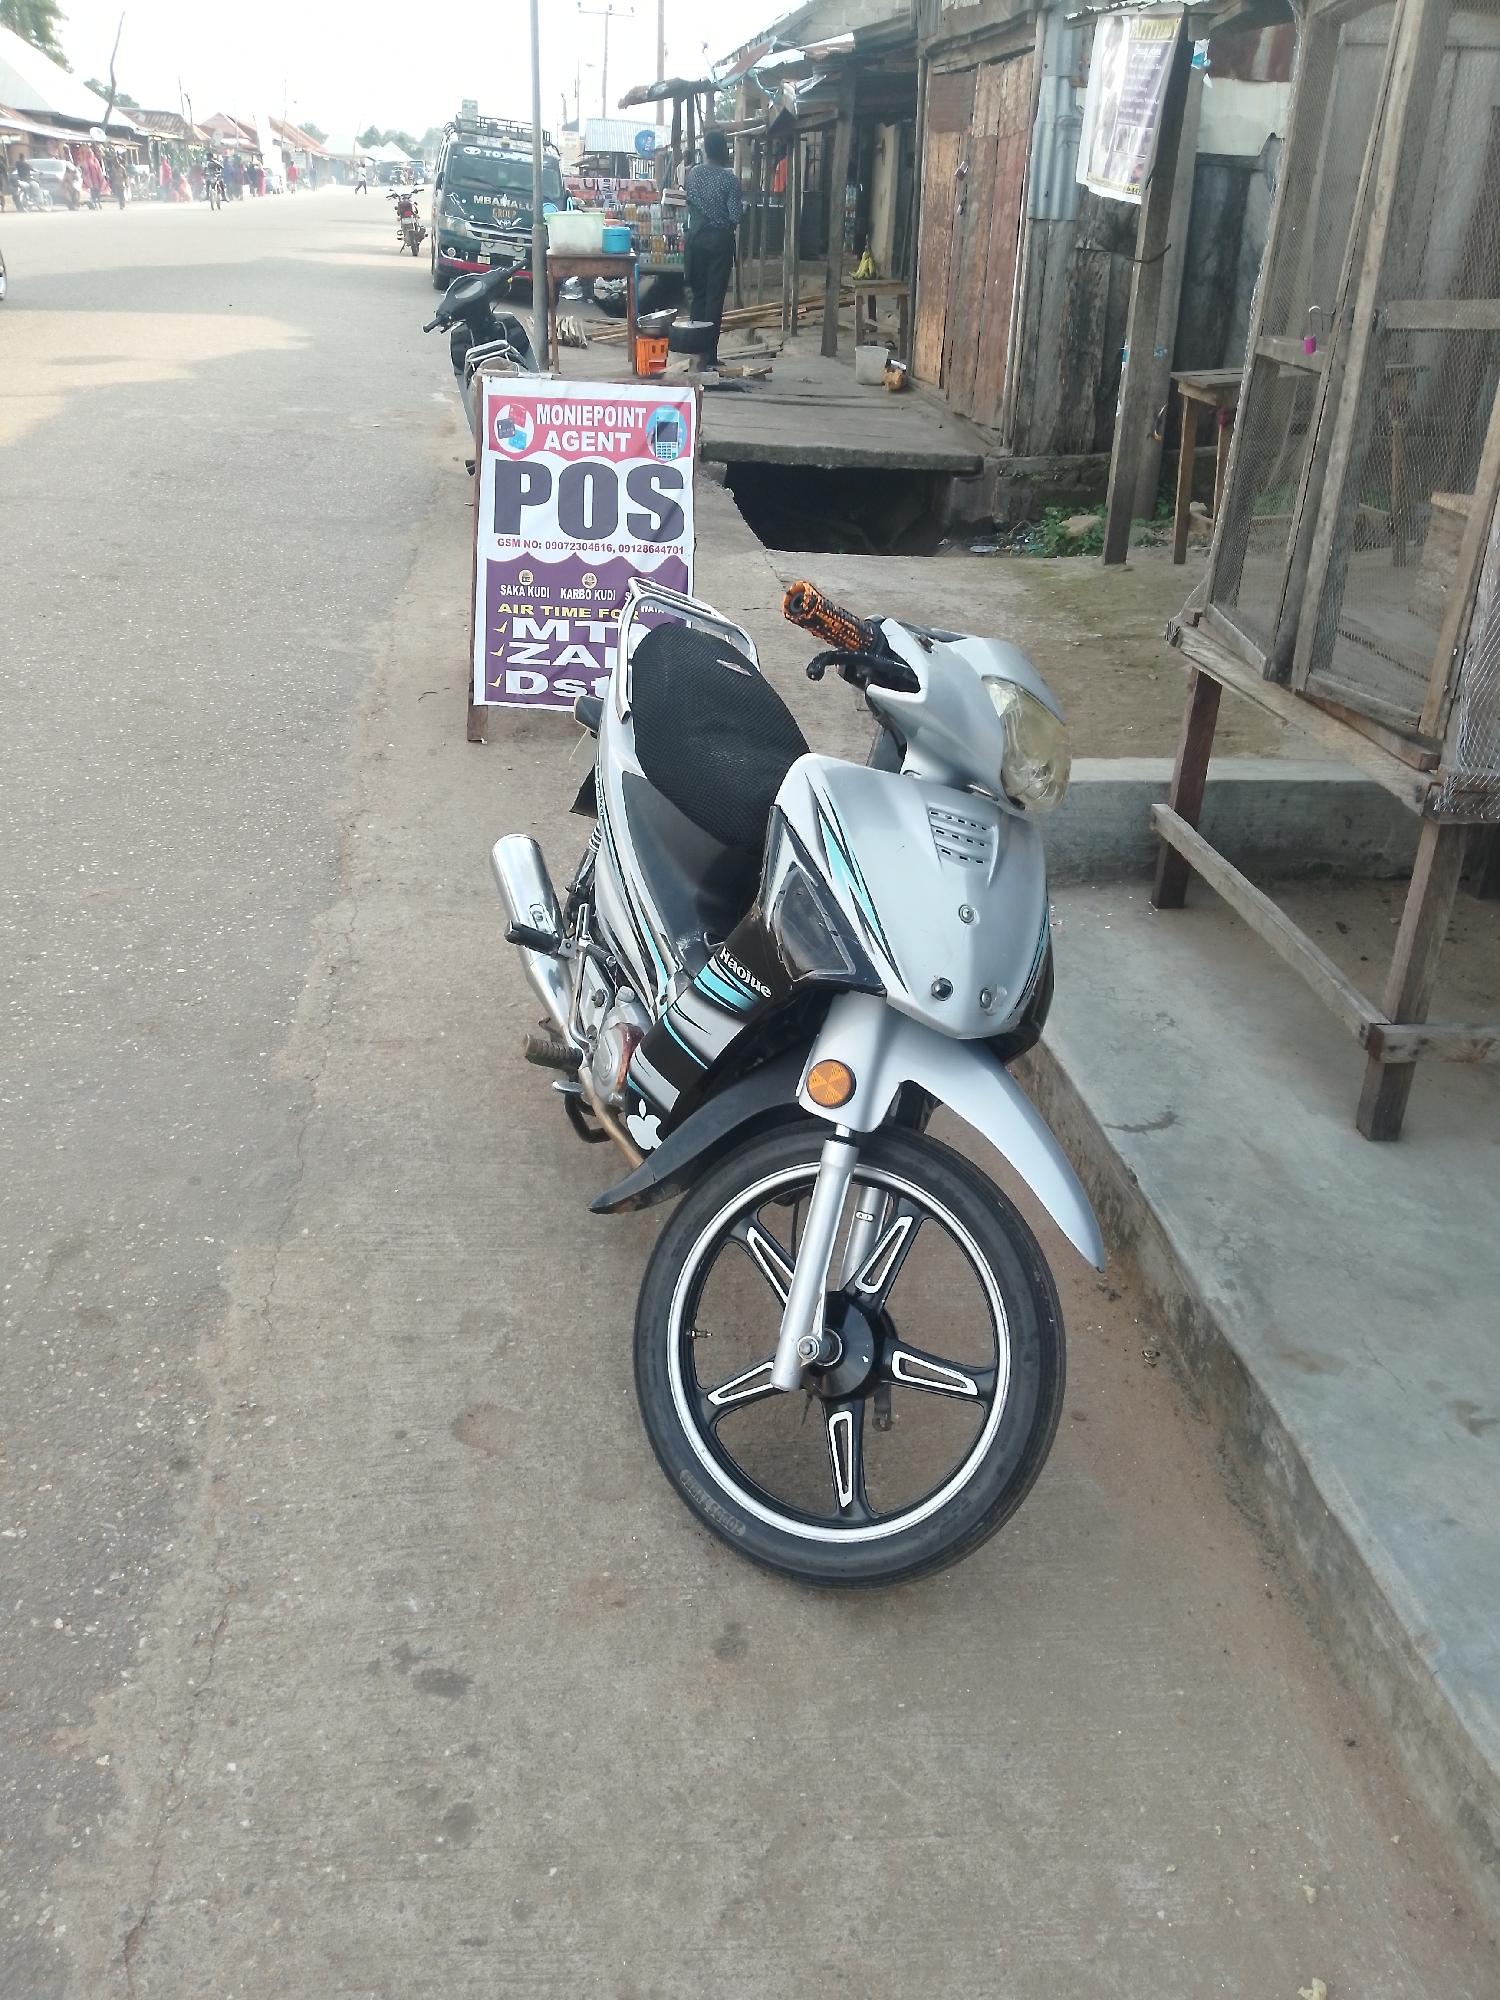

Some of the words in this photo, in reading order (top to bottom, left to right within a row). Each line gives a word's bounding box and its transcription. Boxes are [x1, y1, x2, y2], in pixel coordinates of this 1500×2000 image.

[492, 208, 517, 219] GROUP
[536, 403, 647, 429] MONIEPOINT
[543, 431, 632, 452] AGENT
[494, 459, 685, 543] POS
[497, 539, 520, 549] GSM
[524, 540, 542, 549] NO:
[618, 544, 684, 555] 09128644701
[500, 585, 526, 597] SAKA
[528, 587, 550, 599] KUDI
[560, 588, 591, 600] KARBO
[594, 589, 616, 601] KUDI
[497, 604, 535, 616] AIR
[540, 606, 592, 618] TIME
[720, 946, 771, 997] Haojue
